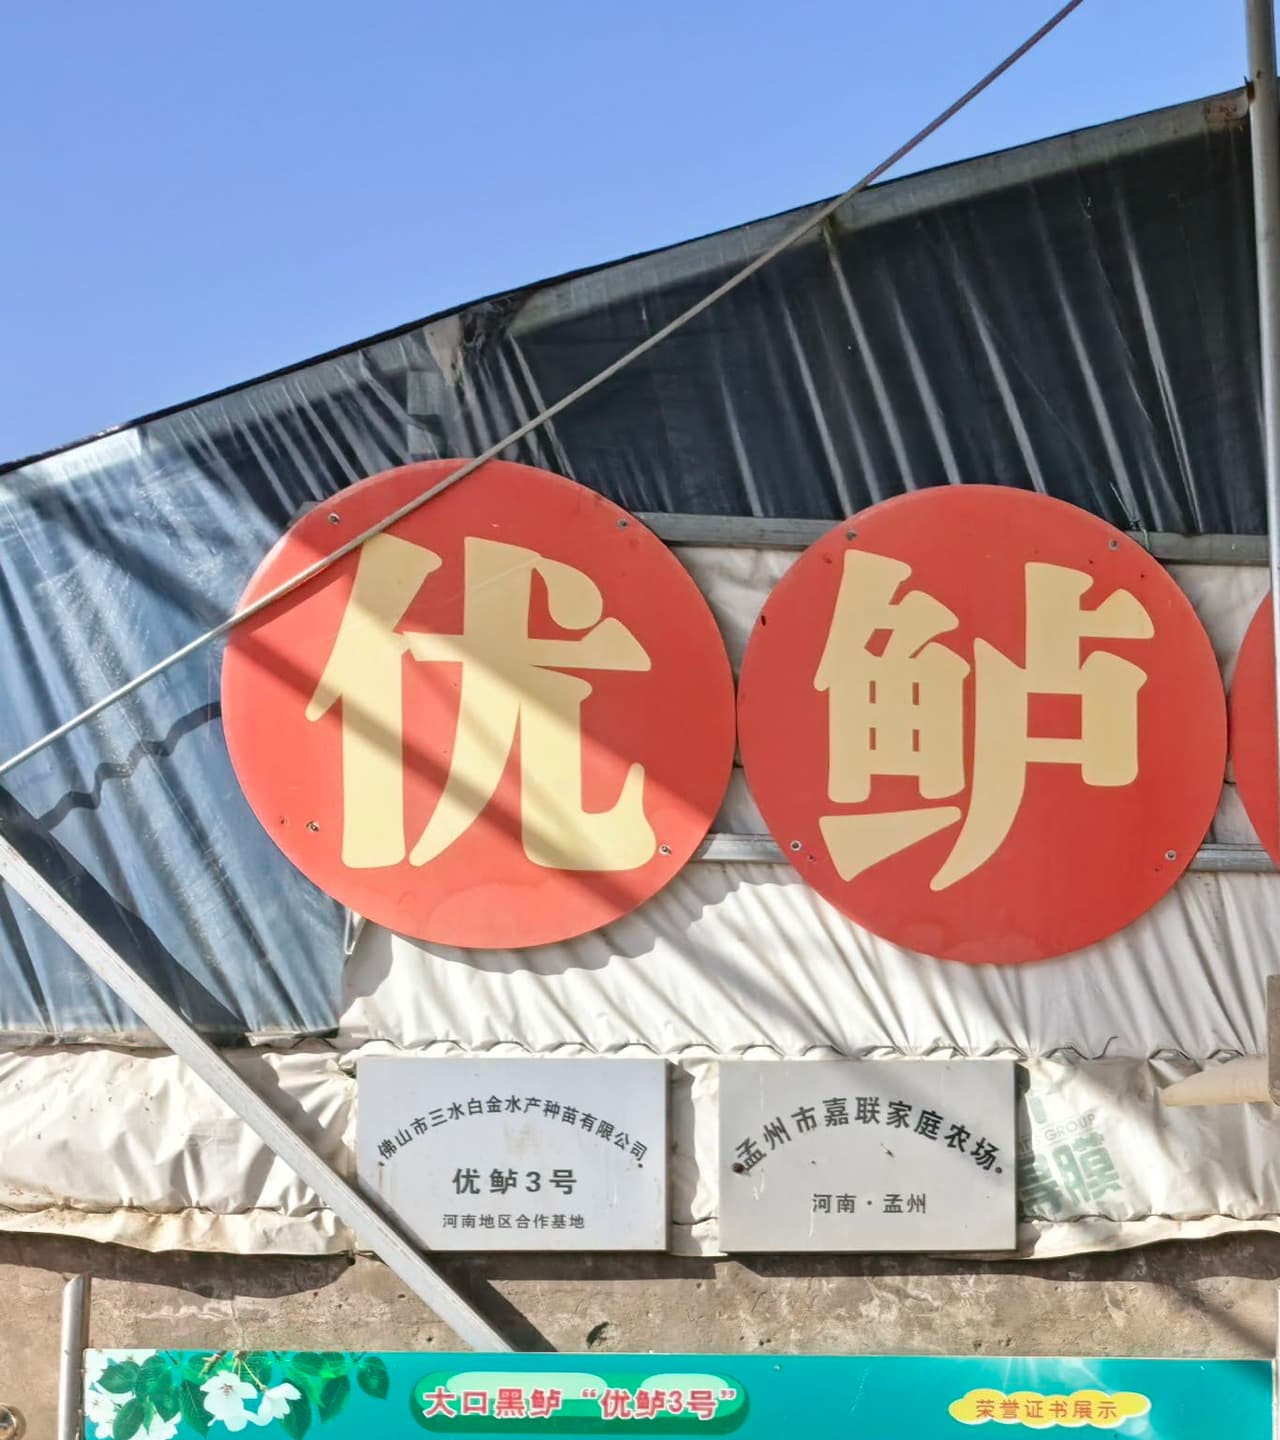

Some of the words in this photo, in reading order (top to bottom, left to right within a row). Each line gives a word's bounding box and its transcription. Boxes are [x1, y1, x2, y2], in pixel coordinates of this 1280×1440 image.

[378, 1094, 649, 1163] 佛山市三水白金水产种苗有限公司
[735, 1095, 1002, 1174] 孟州市嘉联家庭农场
[451, 1166, 579, 1197] 优鲈3号
[811, 1192, 929, 1216] 河南·孟州
[441, 1212, 586, 1232] 河南地区合作基地
[974, 1398, 1120, 1421] 荣誉证书展示
